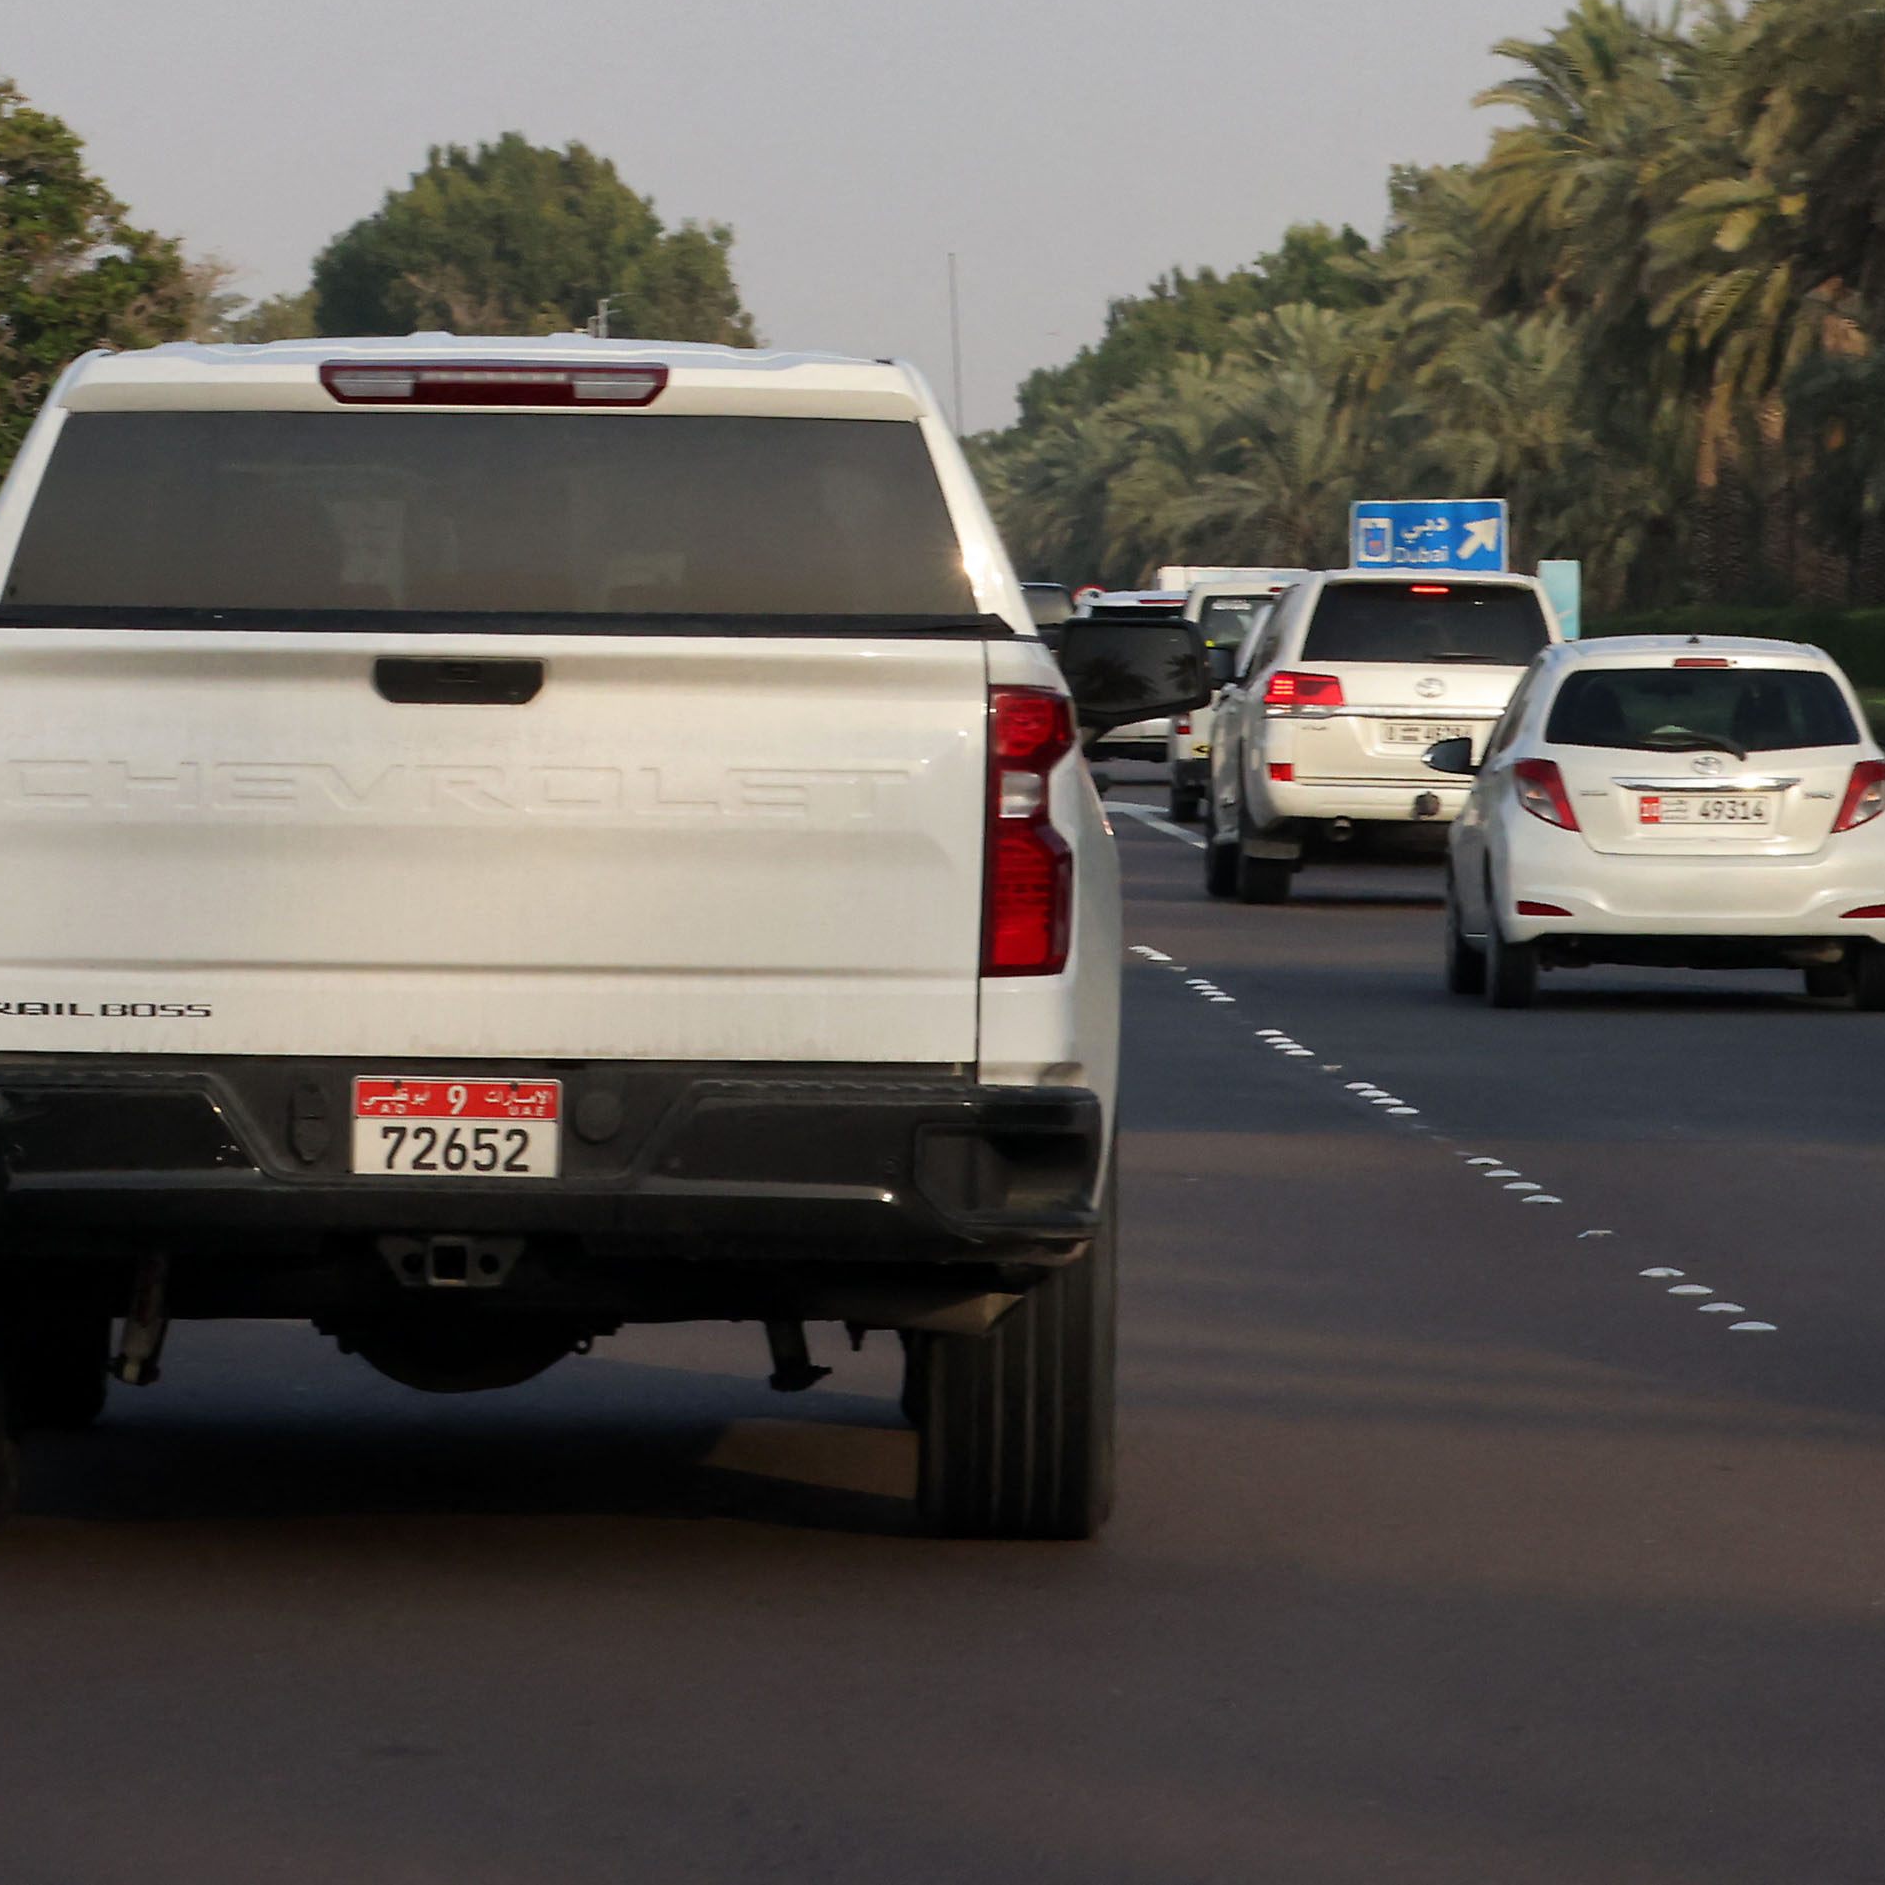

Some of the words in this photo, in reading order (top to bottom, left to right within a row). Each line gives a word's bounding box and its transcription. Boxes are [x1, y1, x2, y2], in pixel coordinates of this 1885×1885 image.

[8, 759, 910, 818] CHEVROLET
[100, 1002, 213, 1018] BOSS
[447, 1084, 468, 1115] 9
[381, 1125, 530, 1173] 72652
